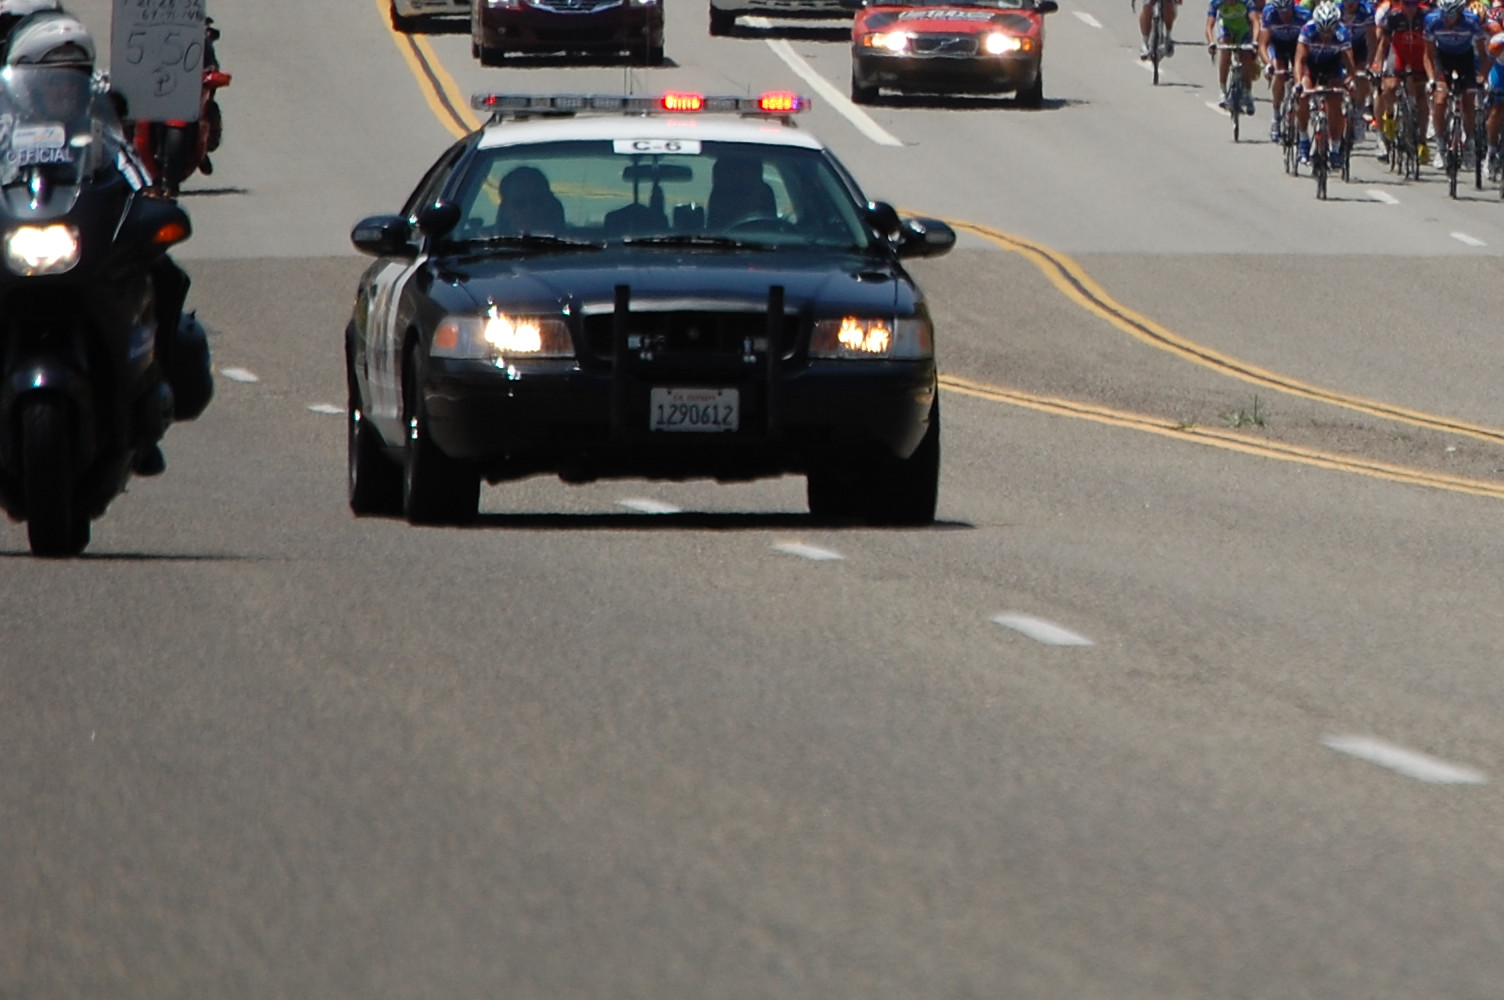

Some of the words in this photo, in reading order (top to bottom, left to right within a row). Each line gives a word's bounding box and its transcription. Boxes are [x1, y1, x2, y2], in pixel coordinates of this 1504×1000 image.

[631, 140, 682, 152] C-6
[7, 147, 73, 166] OFFICIAL
[656, 403, 734, 426] 1290612
